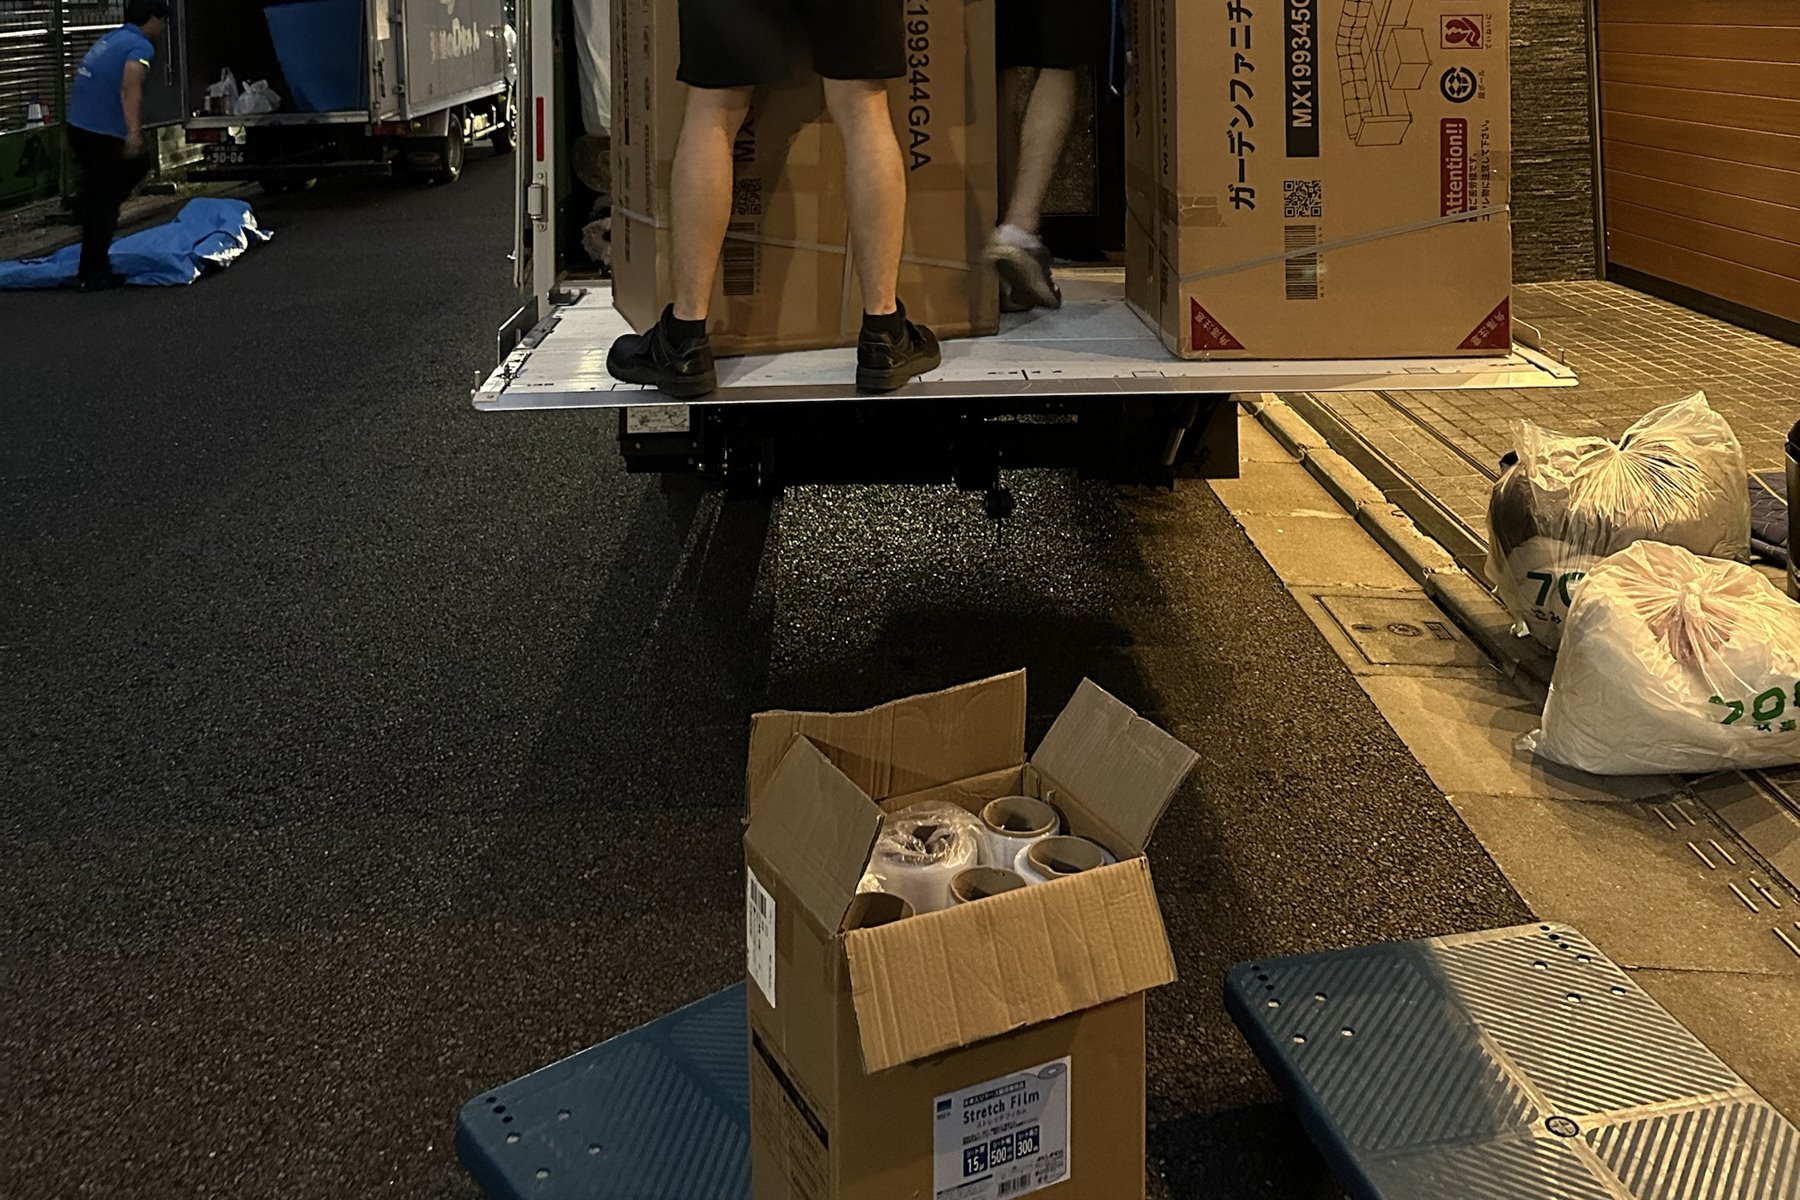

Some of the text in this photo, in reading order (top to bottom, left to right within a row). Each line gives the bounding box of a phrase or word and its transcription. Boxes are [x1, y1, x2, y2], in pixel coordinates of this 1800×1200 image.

[1445, 123, 1463, 216] Attention!!
[1481, 119, 1490, 222] コレ物に注意して下さい。
[963, 1101, 1005, 1124] Stretch
[1011, 1090, 1039, 1109] Film
